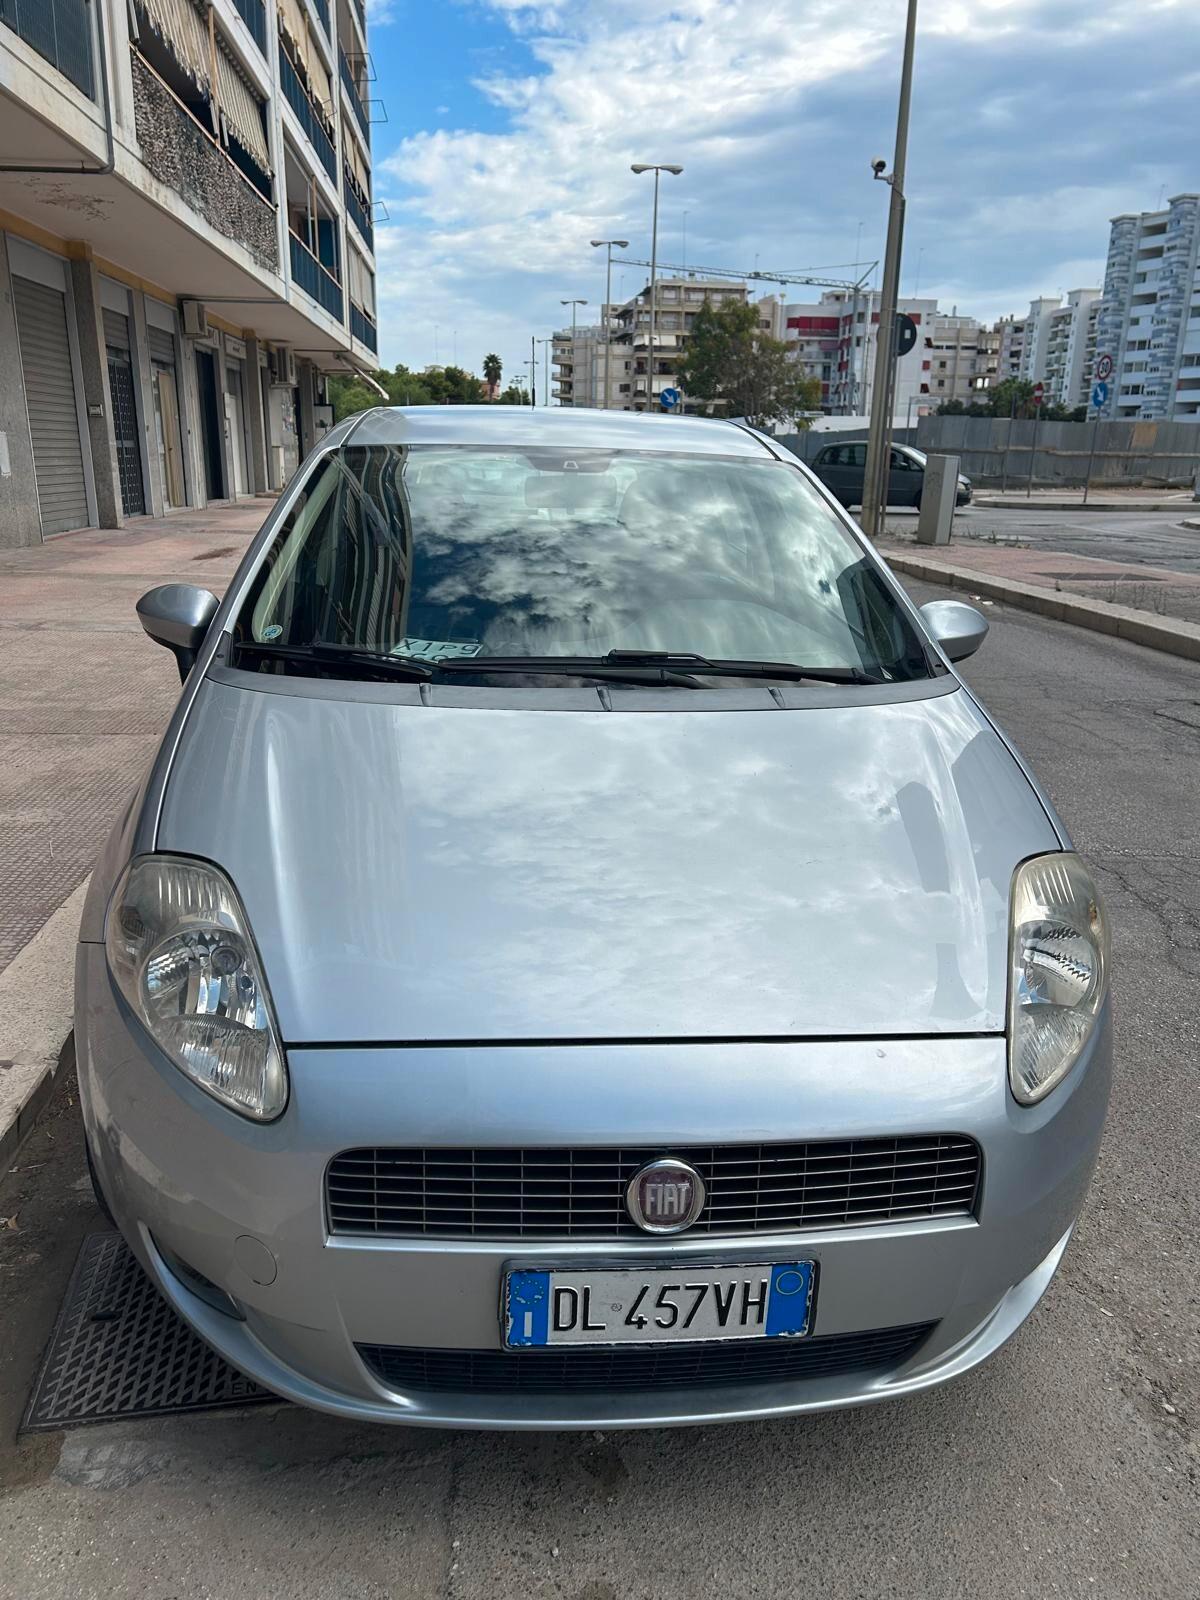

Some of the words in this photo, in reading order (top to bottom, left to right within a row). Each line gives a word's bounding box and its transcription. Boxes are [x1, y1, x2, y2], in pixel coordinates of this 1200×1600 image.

[646, 1183, 690, 1216] FIAT
[553, 1285, 607, 1331] DL
[625, 1279, 768, 1329] 457VH
